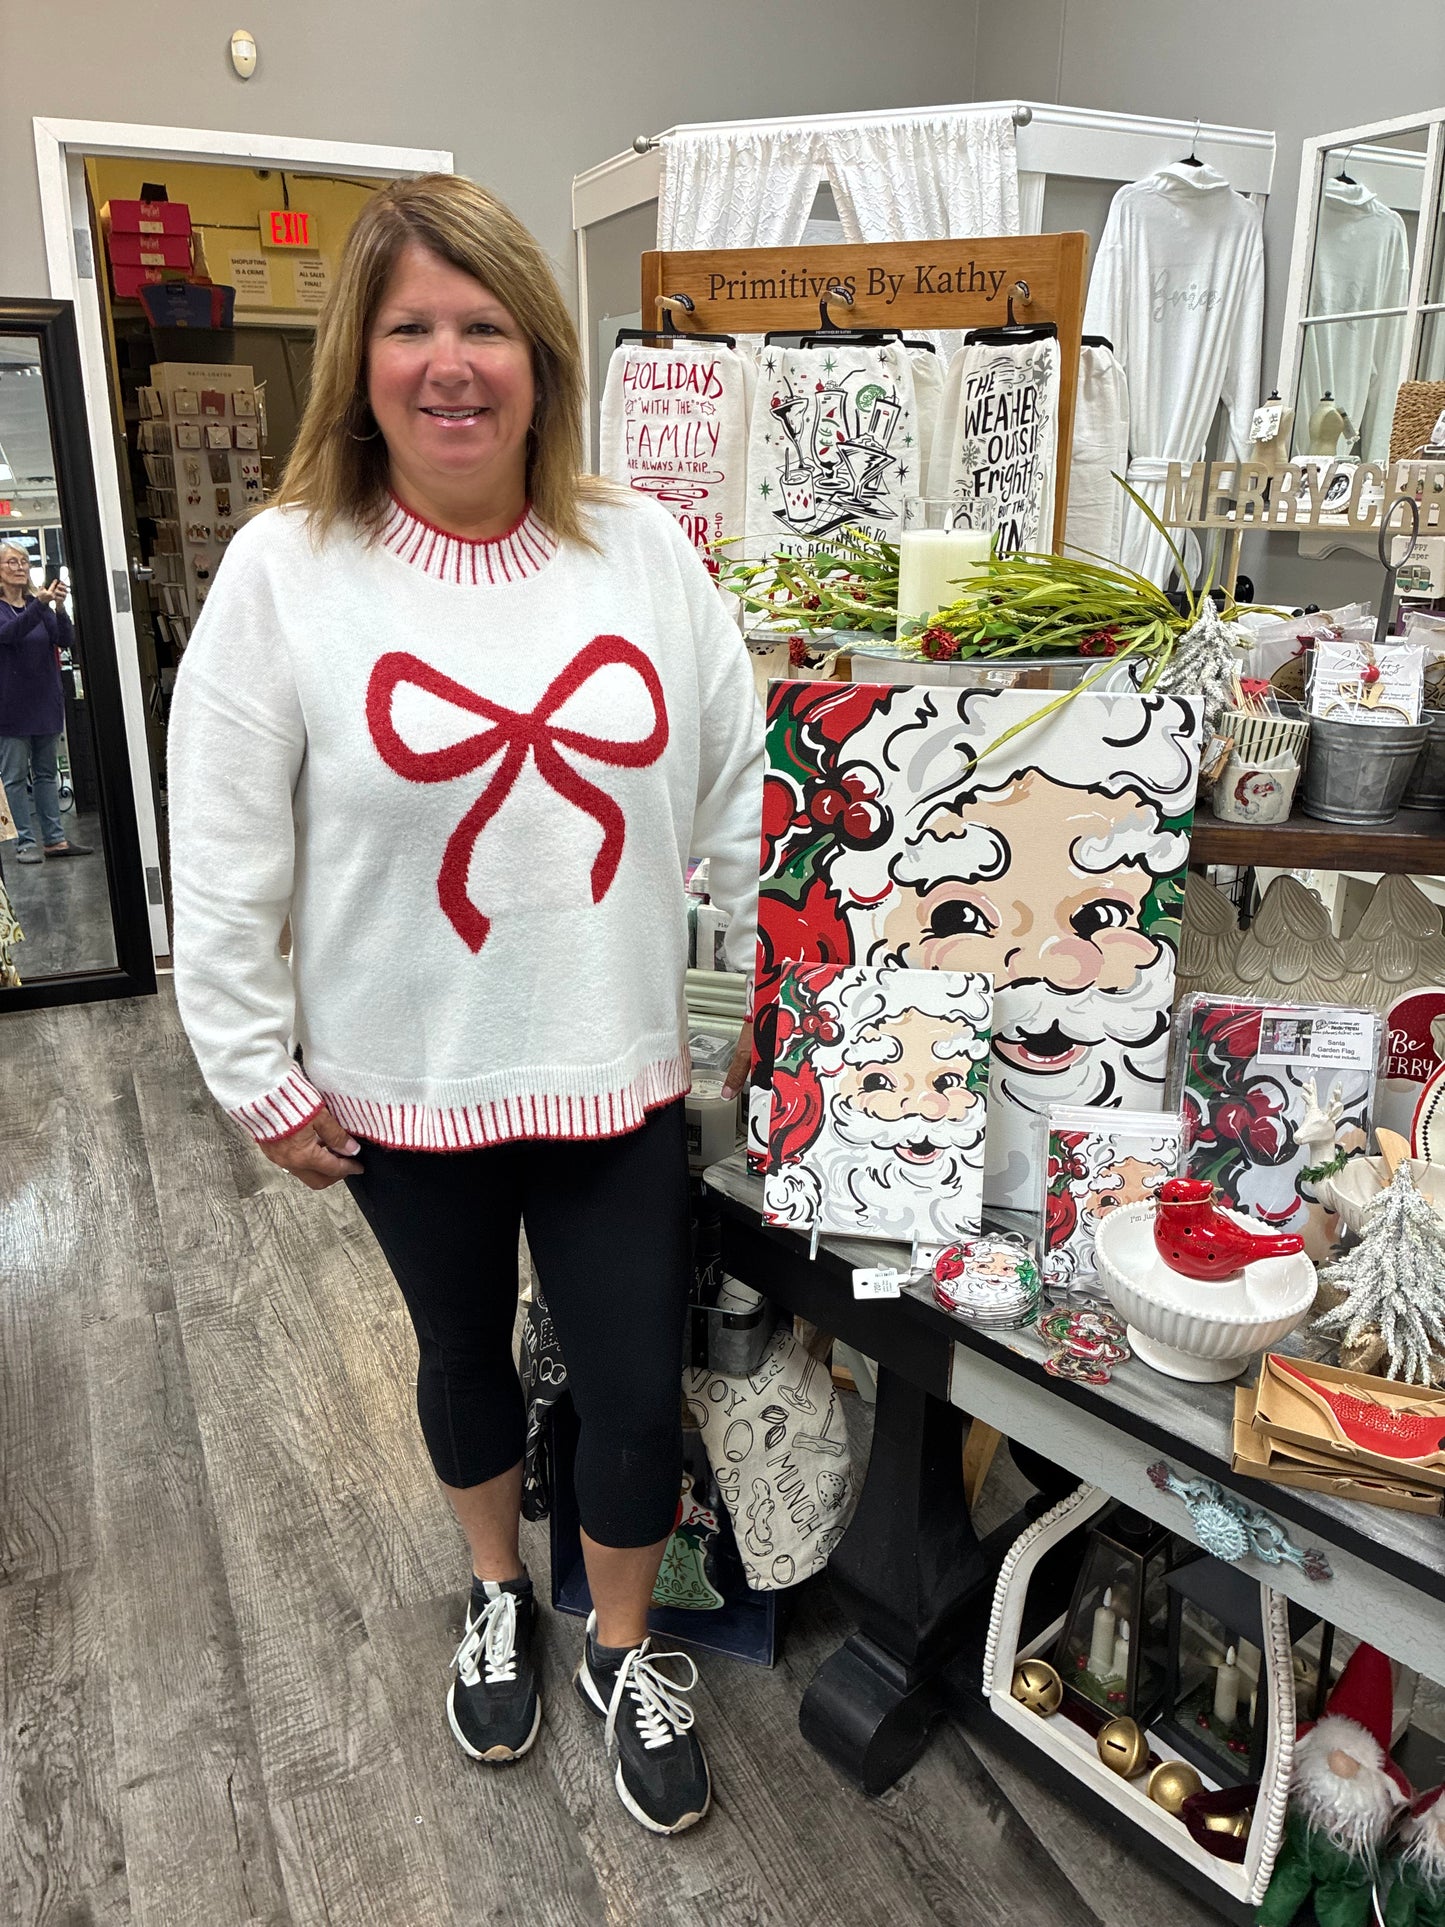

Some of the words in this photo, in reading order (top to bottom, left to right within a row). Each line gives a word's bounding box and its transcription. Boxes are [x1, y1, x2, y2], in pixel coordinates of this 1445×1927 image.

[270, 211, 309, 245] EXIT
[231, 258, 267, 266] SHOPLIFTING
[707, 268, 857, 301] Primitives
[866, 267, 905, 304] By
[913, 260, 1007, 302] Kathy
[623, 360, 724, 400] HOLIDAYS
[966, 371, 996, 401] THE
[641, 399, 670, 416] WITH
[675, 399, 691, 415] THE
[964, 384, 1040, 440] WEAHER
[626, 419, 721, 459] FAMILY
[627, 459, 639, 470] ARE
[642, 460, 673, 472] ALWAYS
[677, 461, 684, 472] A
[972, 454, 1035, 503] Frightf
[1162, 462, 1338, 526] MERRY
[714, 512, 723, 555] STOE
[1317, 1046, 1340, 1054] Garden
[1327, 1039, 1346, 1047] Santa
[1388, 1028, 1426, 1054] Be
[1130, 1215, 1142, 1224] I'm
[1143, 1212, 1156, 1222] jus
[683, 1364, 747, 1418] NJOY
[766, 1451, 823, 1541] MUNCH
